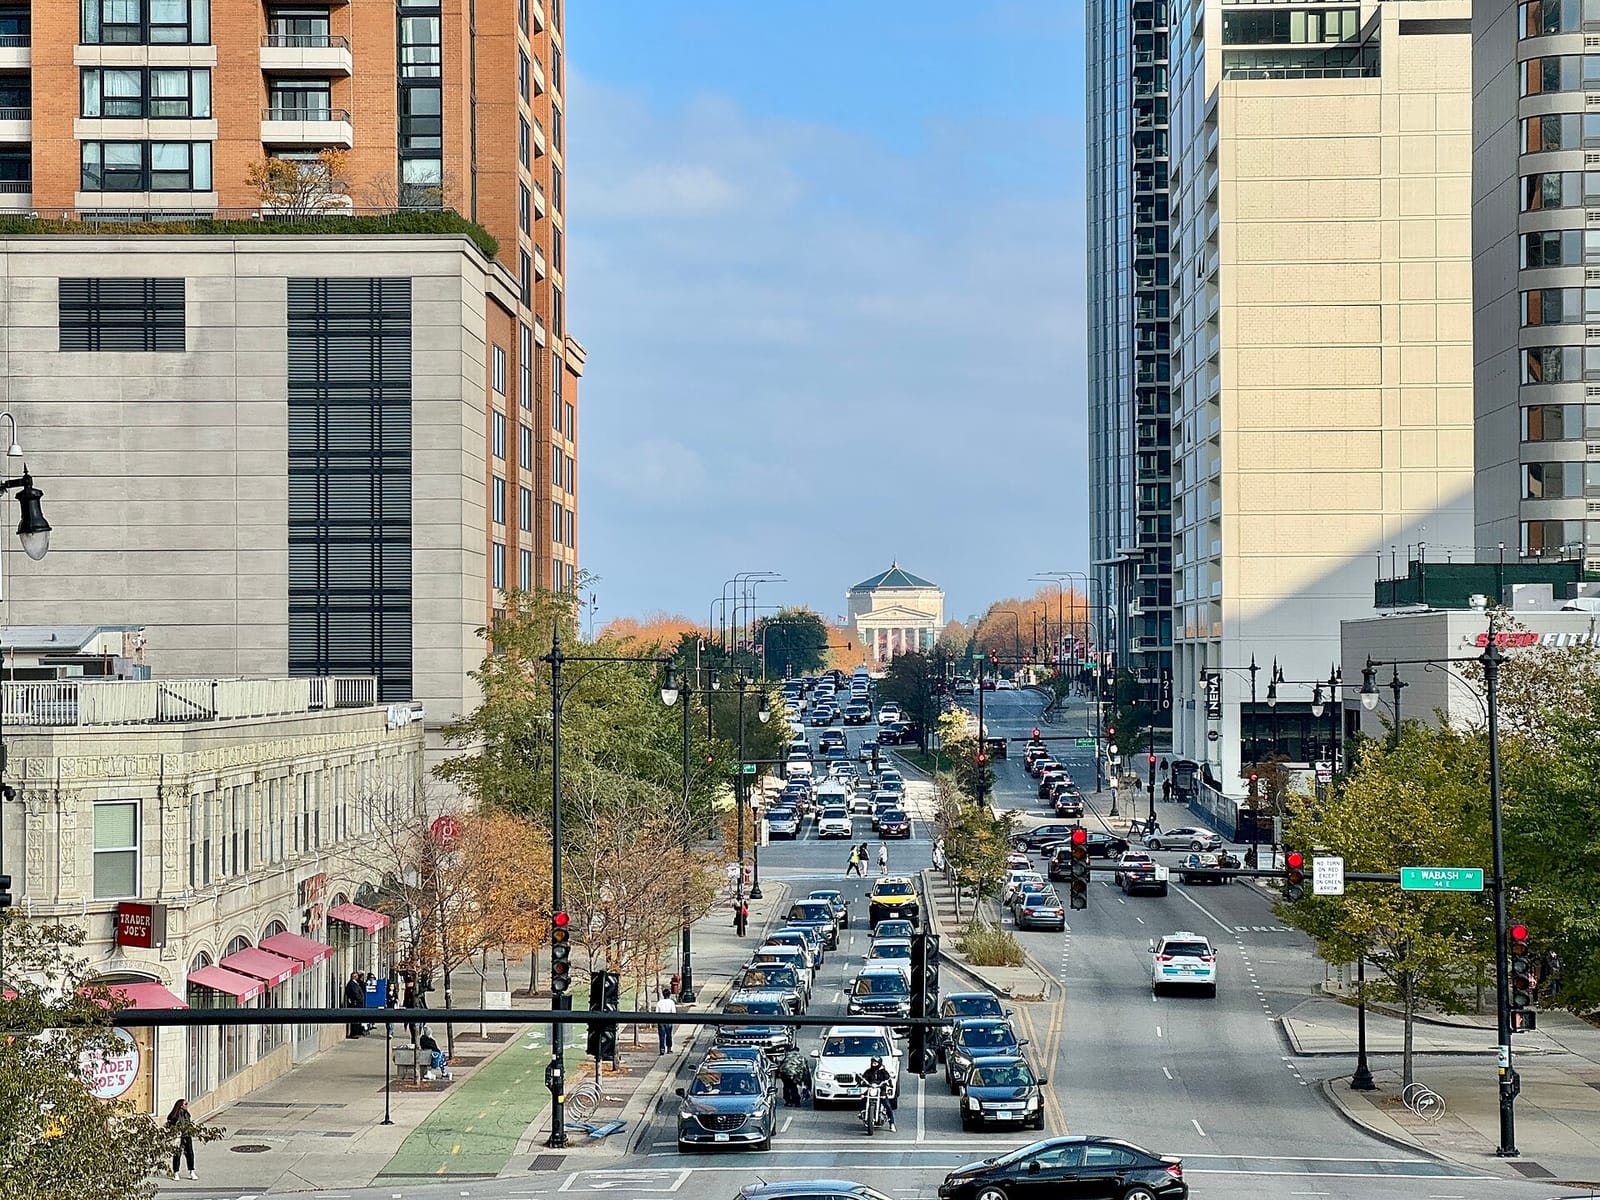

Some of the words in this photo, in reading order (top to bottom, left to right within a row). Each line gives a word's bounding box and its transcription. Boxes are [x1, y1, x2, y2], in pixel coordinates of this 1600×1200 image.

[1209, 676, 1219, 710] NEMA
[1421, 871, 1459, 880] WABASH
[120, 914, 151, 926] TRADER
[123, 926, 147, 937] JOE'S
